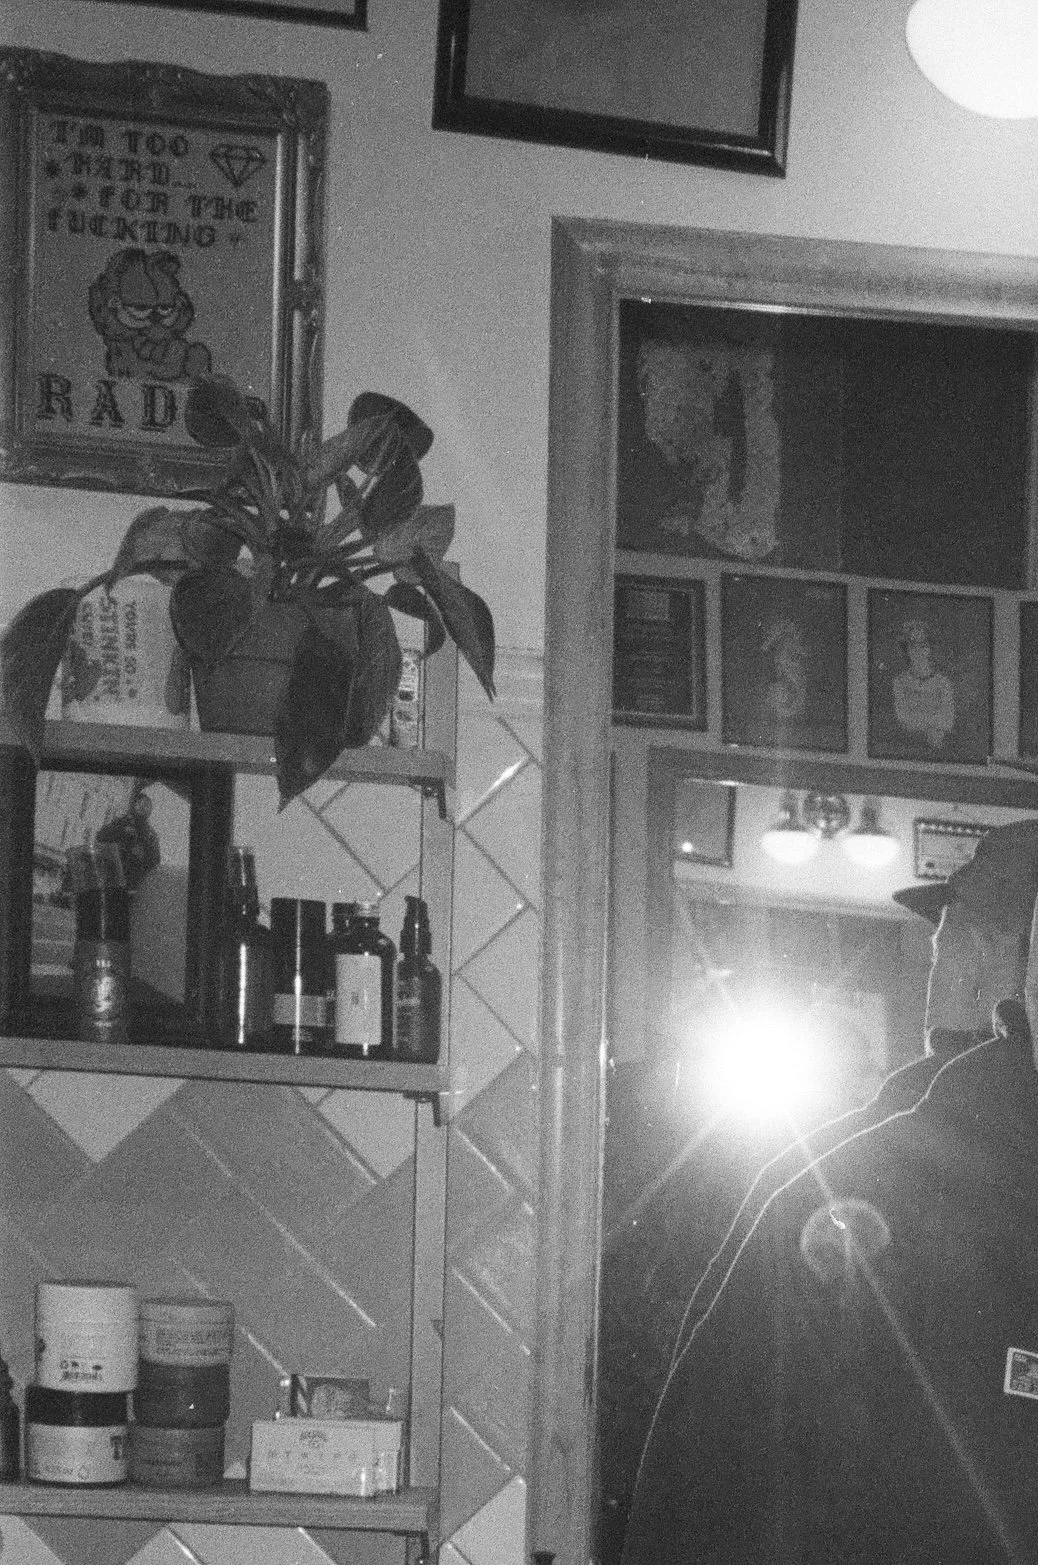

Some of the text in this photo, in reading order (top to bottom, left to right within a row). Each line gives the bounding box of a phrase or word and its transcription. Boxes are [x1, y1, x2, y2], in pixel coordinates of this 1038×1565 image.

[50, 120, 190, 157] I'M TOO
[98, 184, 259, 224] FOR THE
[46, 207, 217, 248] FUCKING
